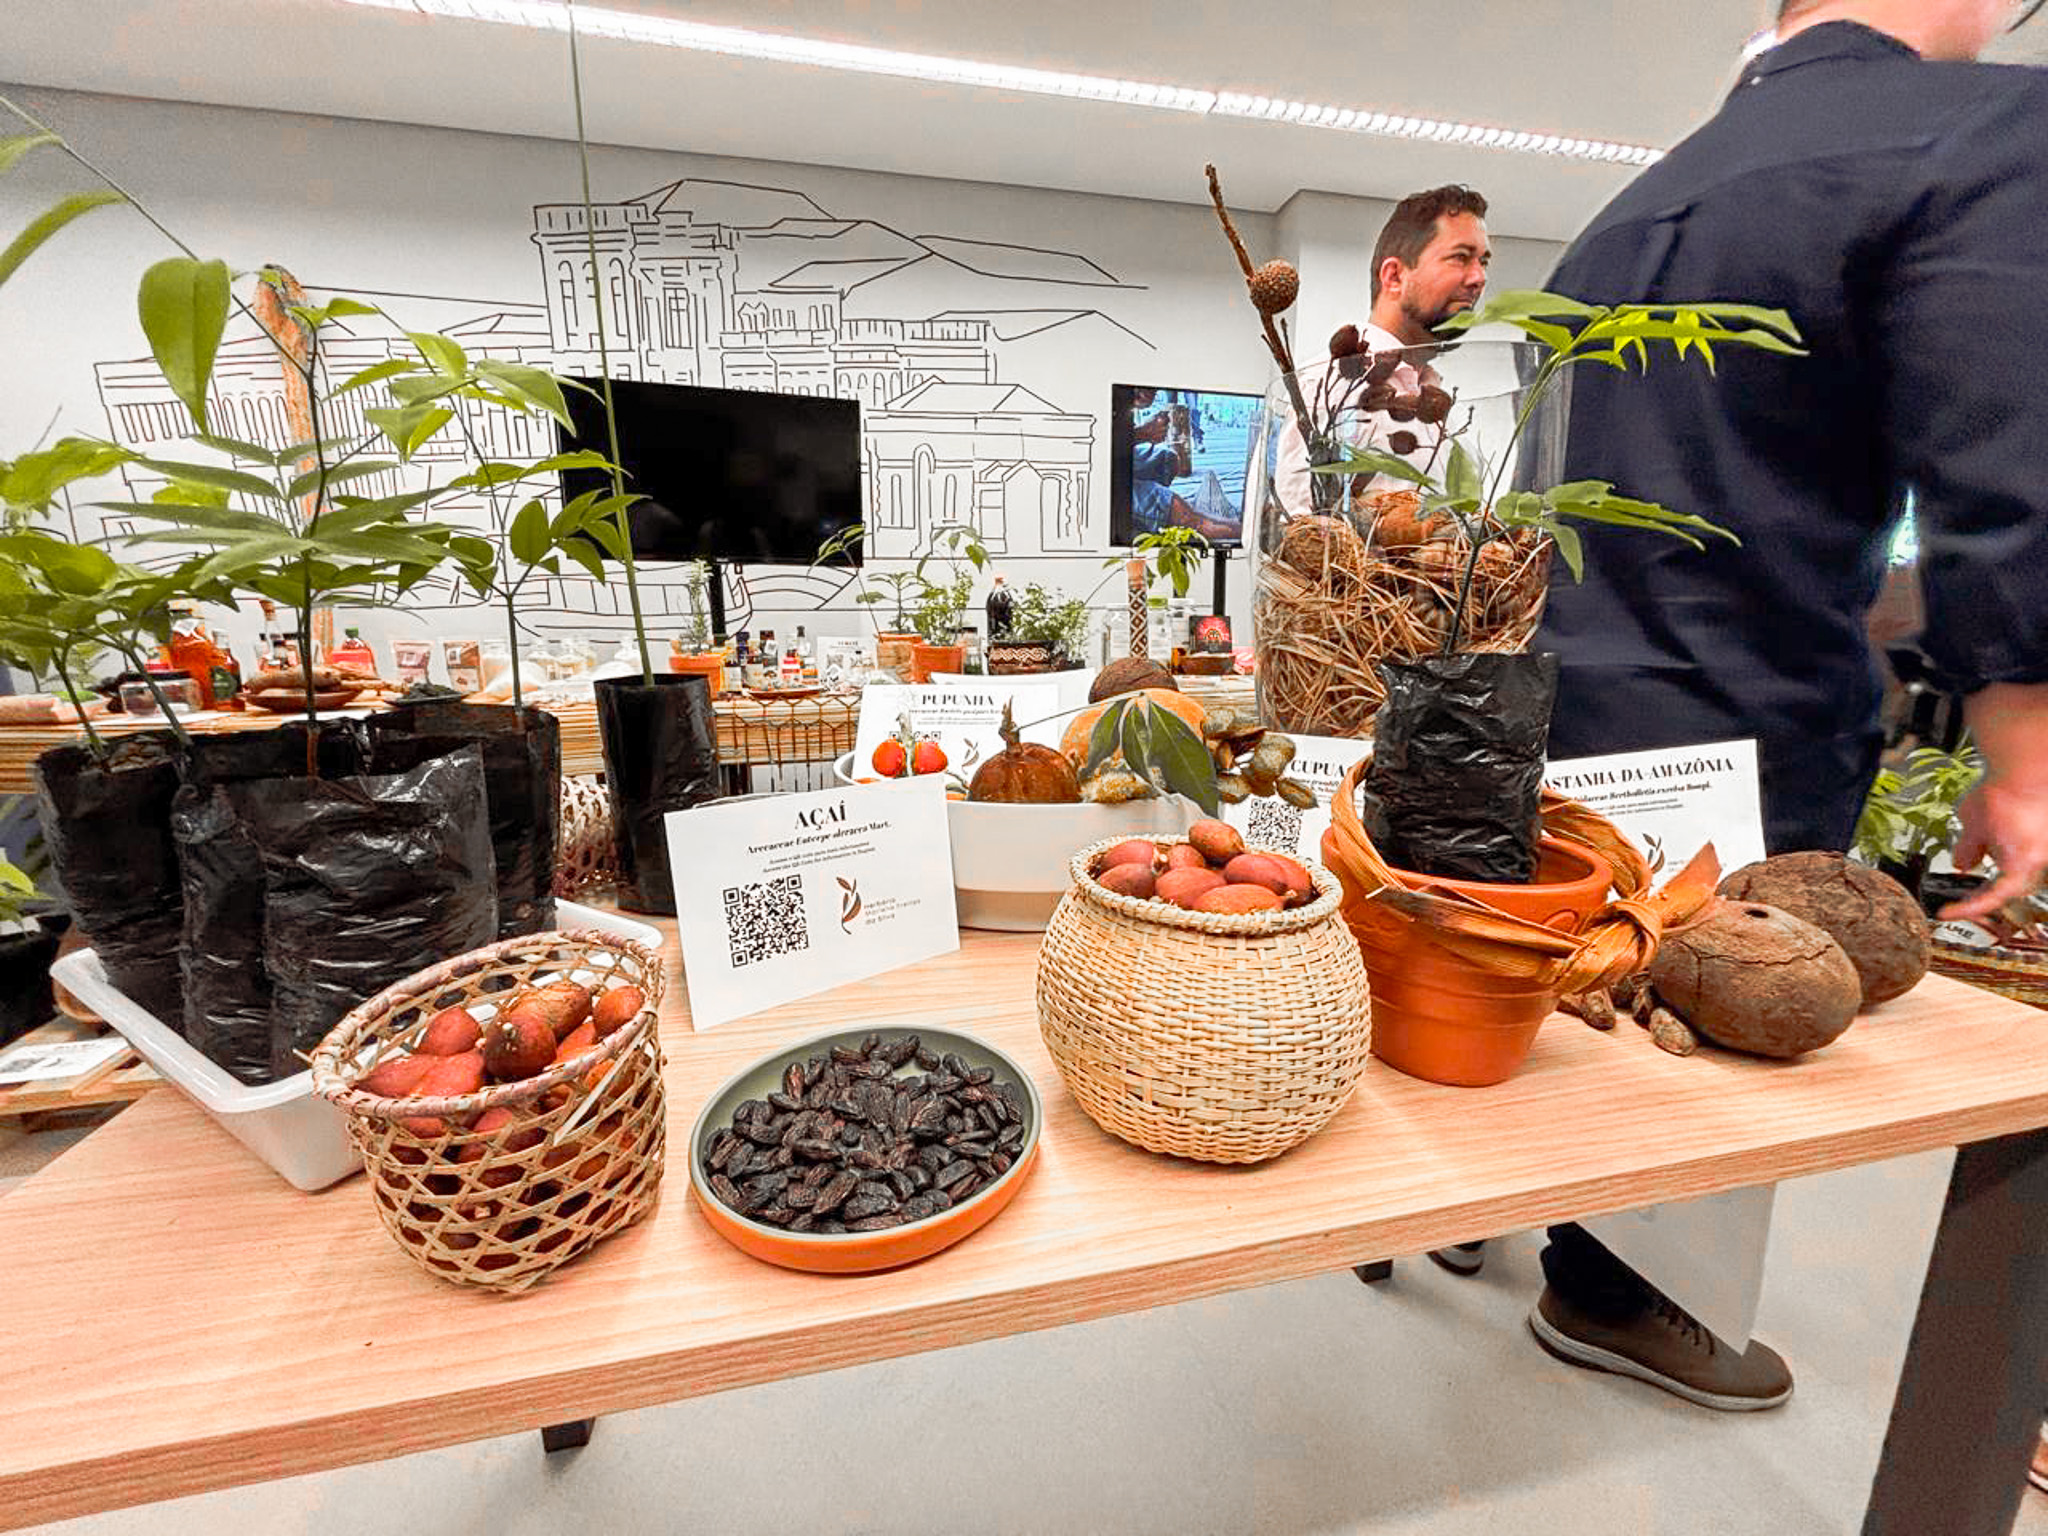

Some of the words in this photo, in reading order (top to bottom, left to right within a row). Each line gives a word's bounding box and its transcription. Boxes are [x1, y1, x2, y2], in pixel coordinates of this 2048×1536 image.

[922, 694, 993, 706] PUPUNHA
[1290, 760, 1344, 777] CUPUA
[794, 800, 847, 831] AÇAÍ
